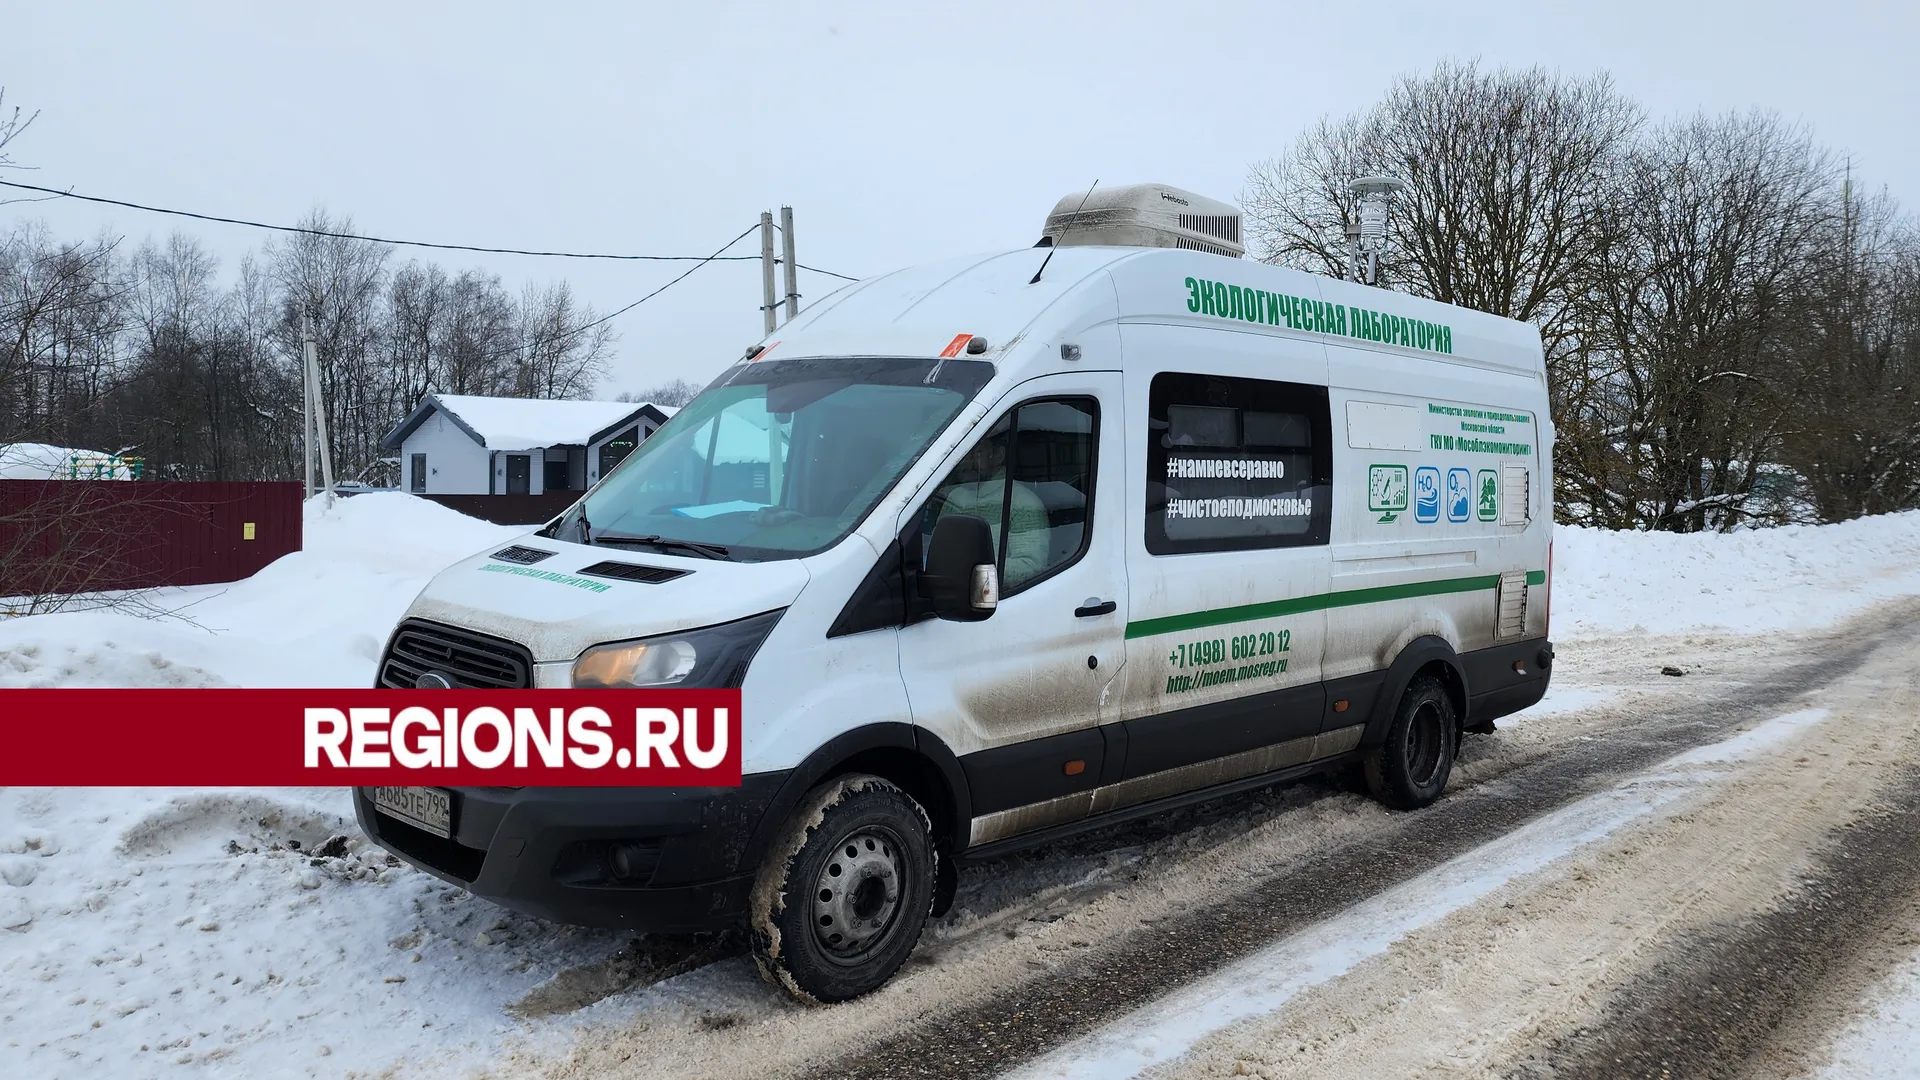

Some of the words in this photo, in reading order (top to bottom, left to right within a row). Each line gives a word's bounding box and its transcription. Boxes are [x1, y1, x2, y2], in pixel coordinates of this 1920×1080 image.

[1185, 276, 1347, 336] ЭКОЛОГИЧЕСКАЯ
[1350, 306, 1452, 354] ЛАБОРАТОРИЯ
[1428, 403, 1462, 417] Министерство
[1463, 408, 1484, 419] экологии
[1461, 421, 1487, 433] Московской
[1488, 424, 1505, 434] области
[1431, 434, 1442, 449] ГКУ
[1443, 435, 1454, 451] МО
[1167, 457, 1285, 481] #намневсеравно
[1167, 497, 1312, 520] #чистоеподмосковье
[539, 571, 612, 593] ЛАБОРАТОРИЯ
[1169, 644, 1186, 669] +7
[1189, 638, 1226, 667] (498)
[1231, 633, 1257, 661] 602
[1259, 631, 1275, 656] 20
[1278, 629, 1291, 653] 12
[1166, 658, 1288, 694] http://moem.mosreg.ru
